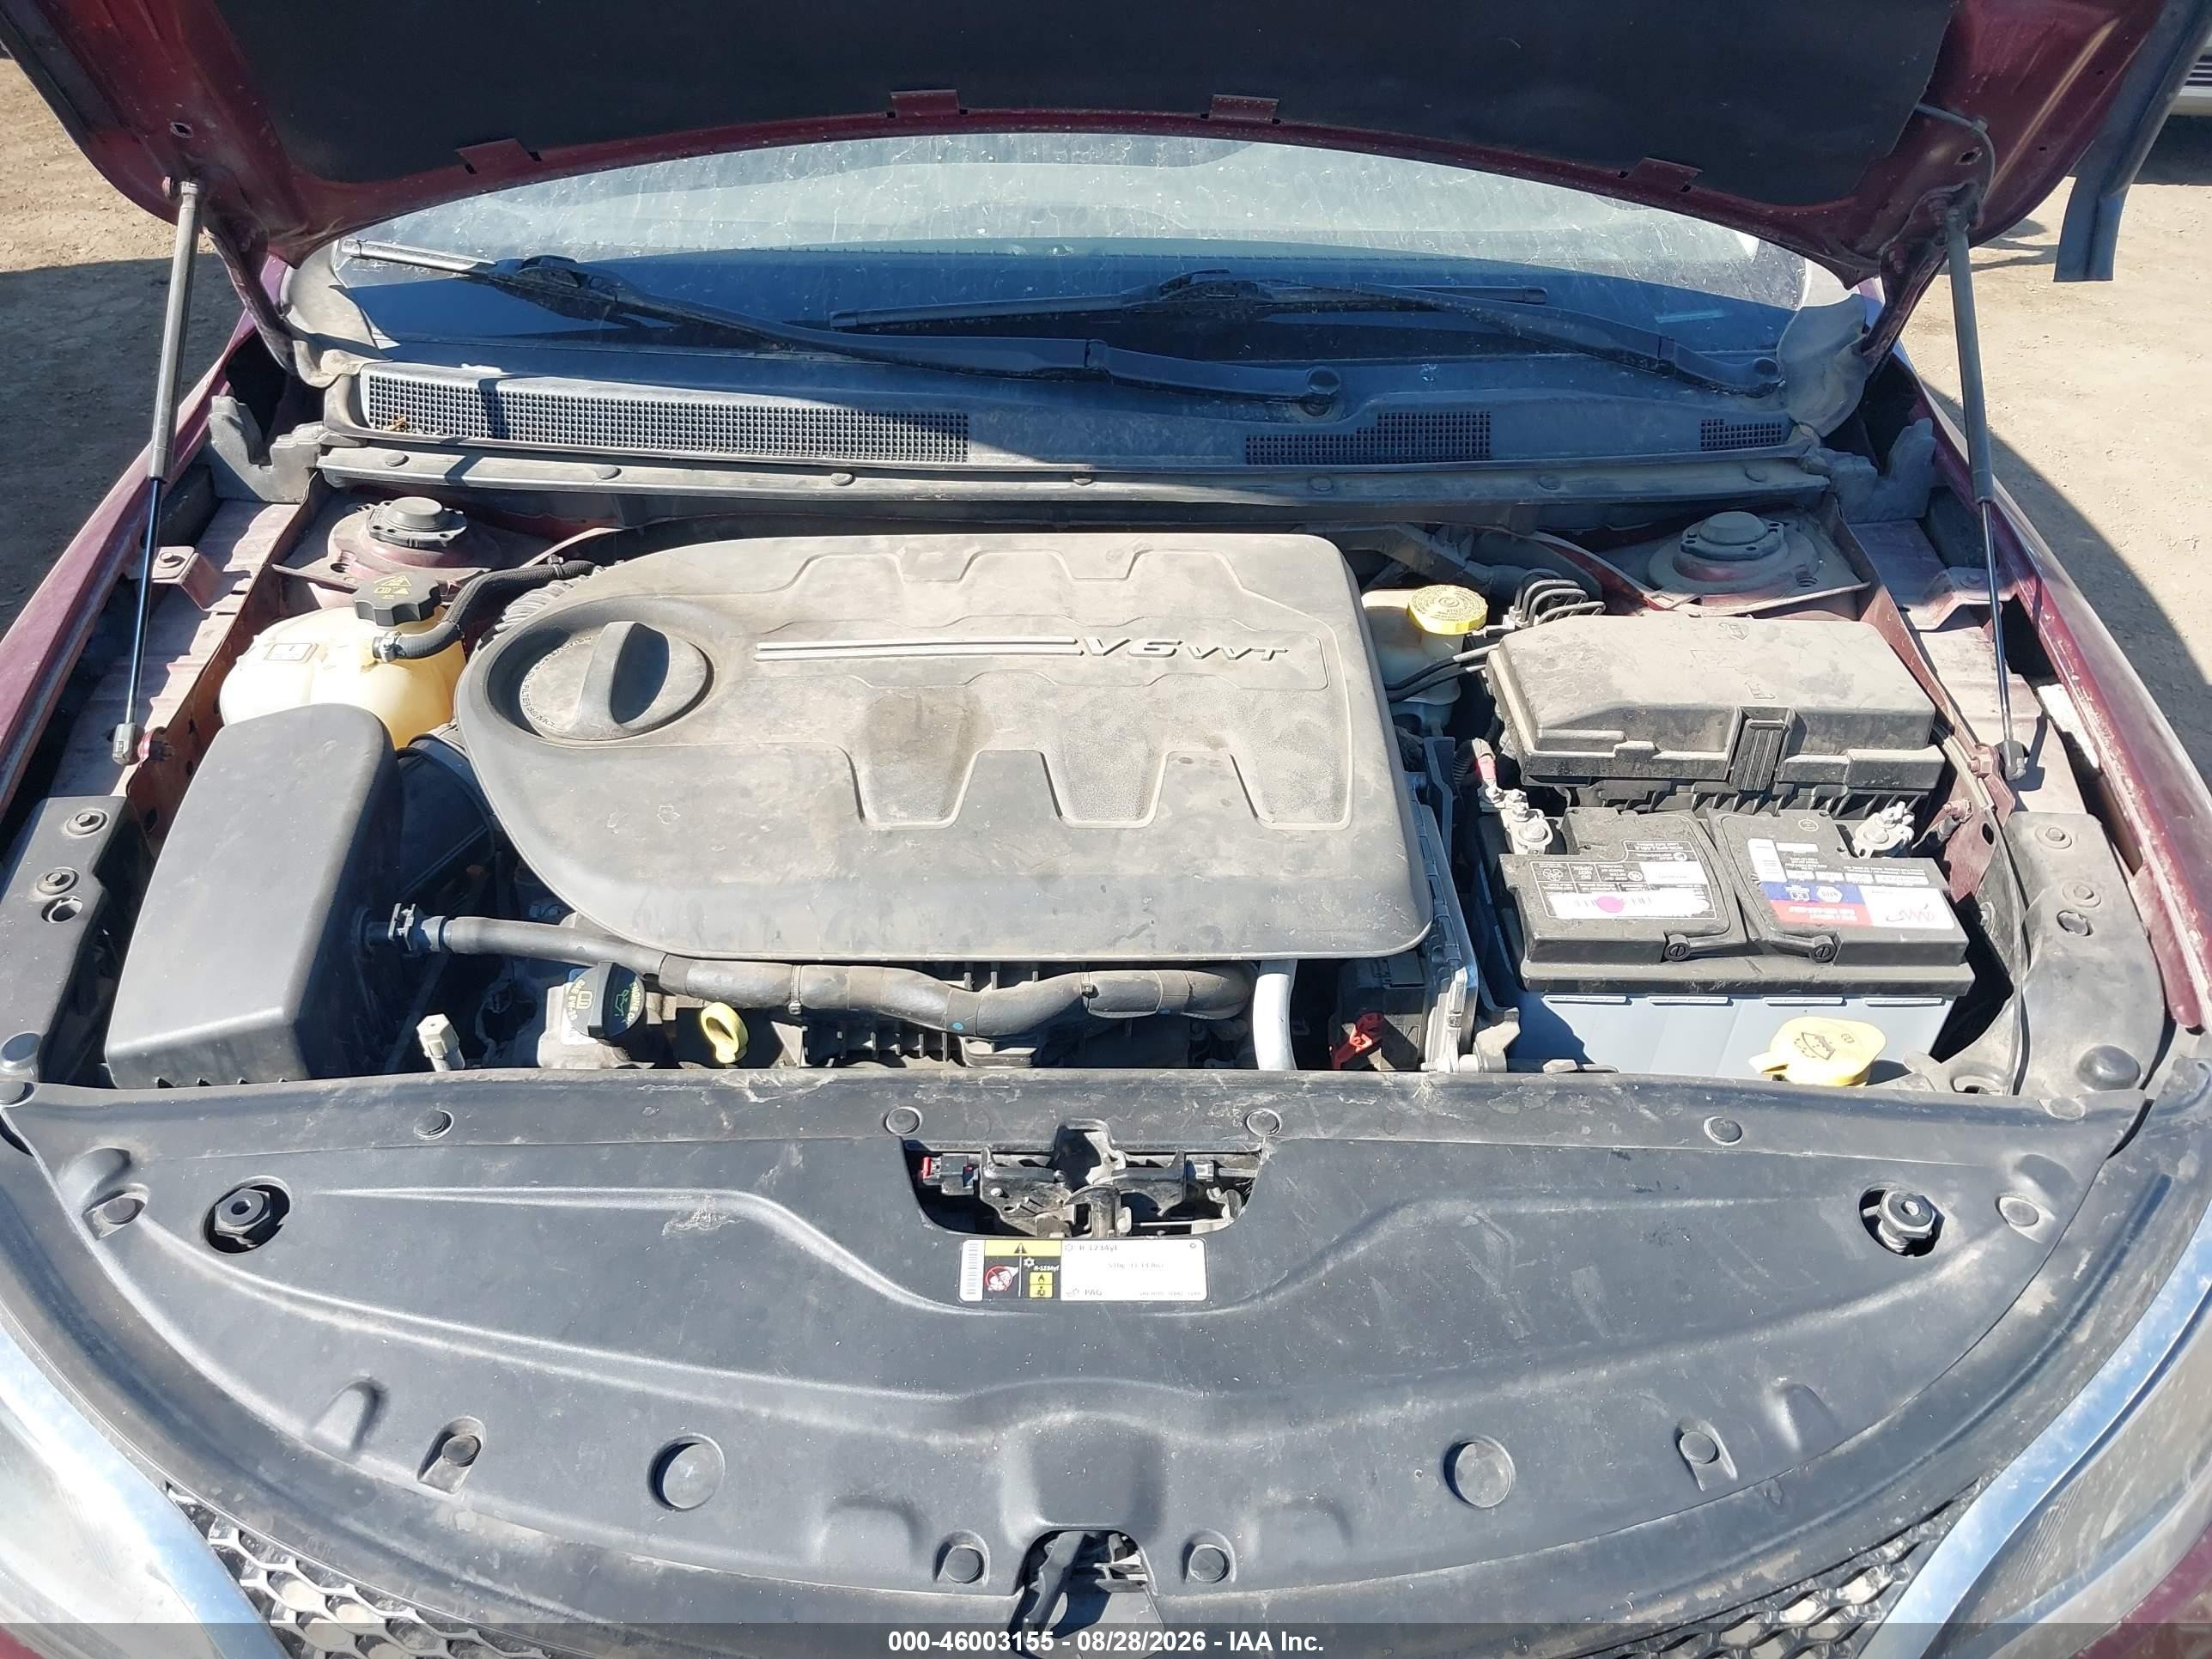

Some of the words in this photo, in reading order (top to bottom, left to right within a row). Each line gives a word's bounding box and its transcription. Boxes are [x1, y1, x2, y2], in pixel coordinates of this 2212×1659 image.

[1082, 637, 1182, 658] V6
[1188, 645, 1291, 662] VVT
[521, 684, 532, 708] FILTER
[629, 981, 641, 1012] ENGINE
